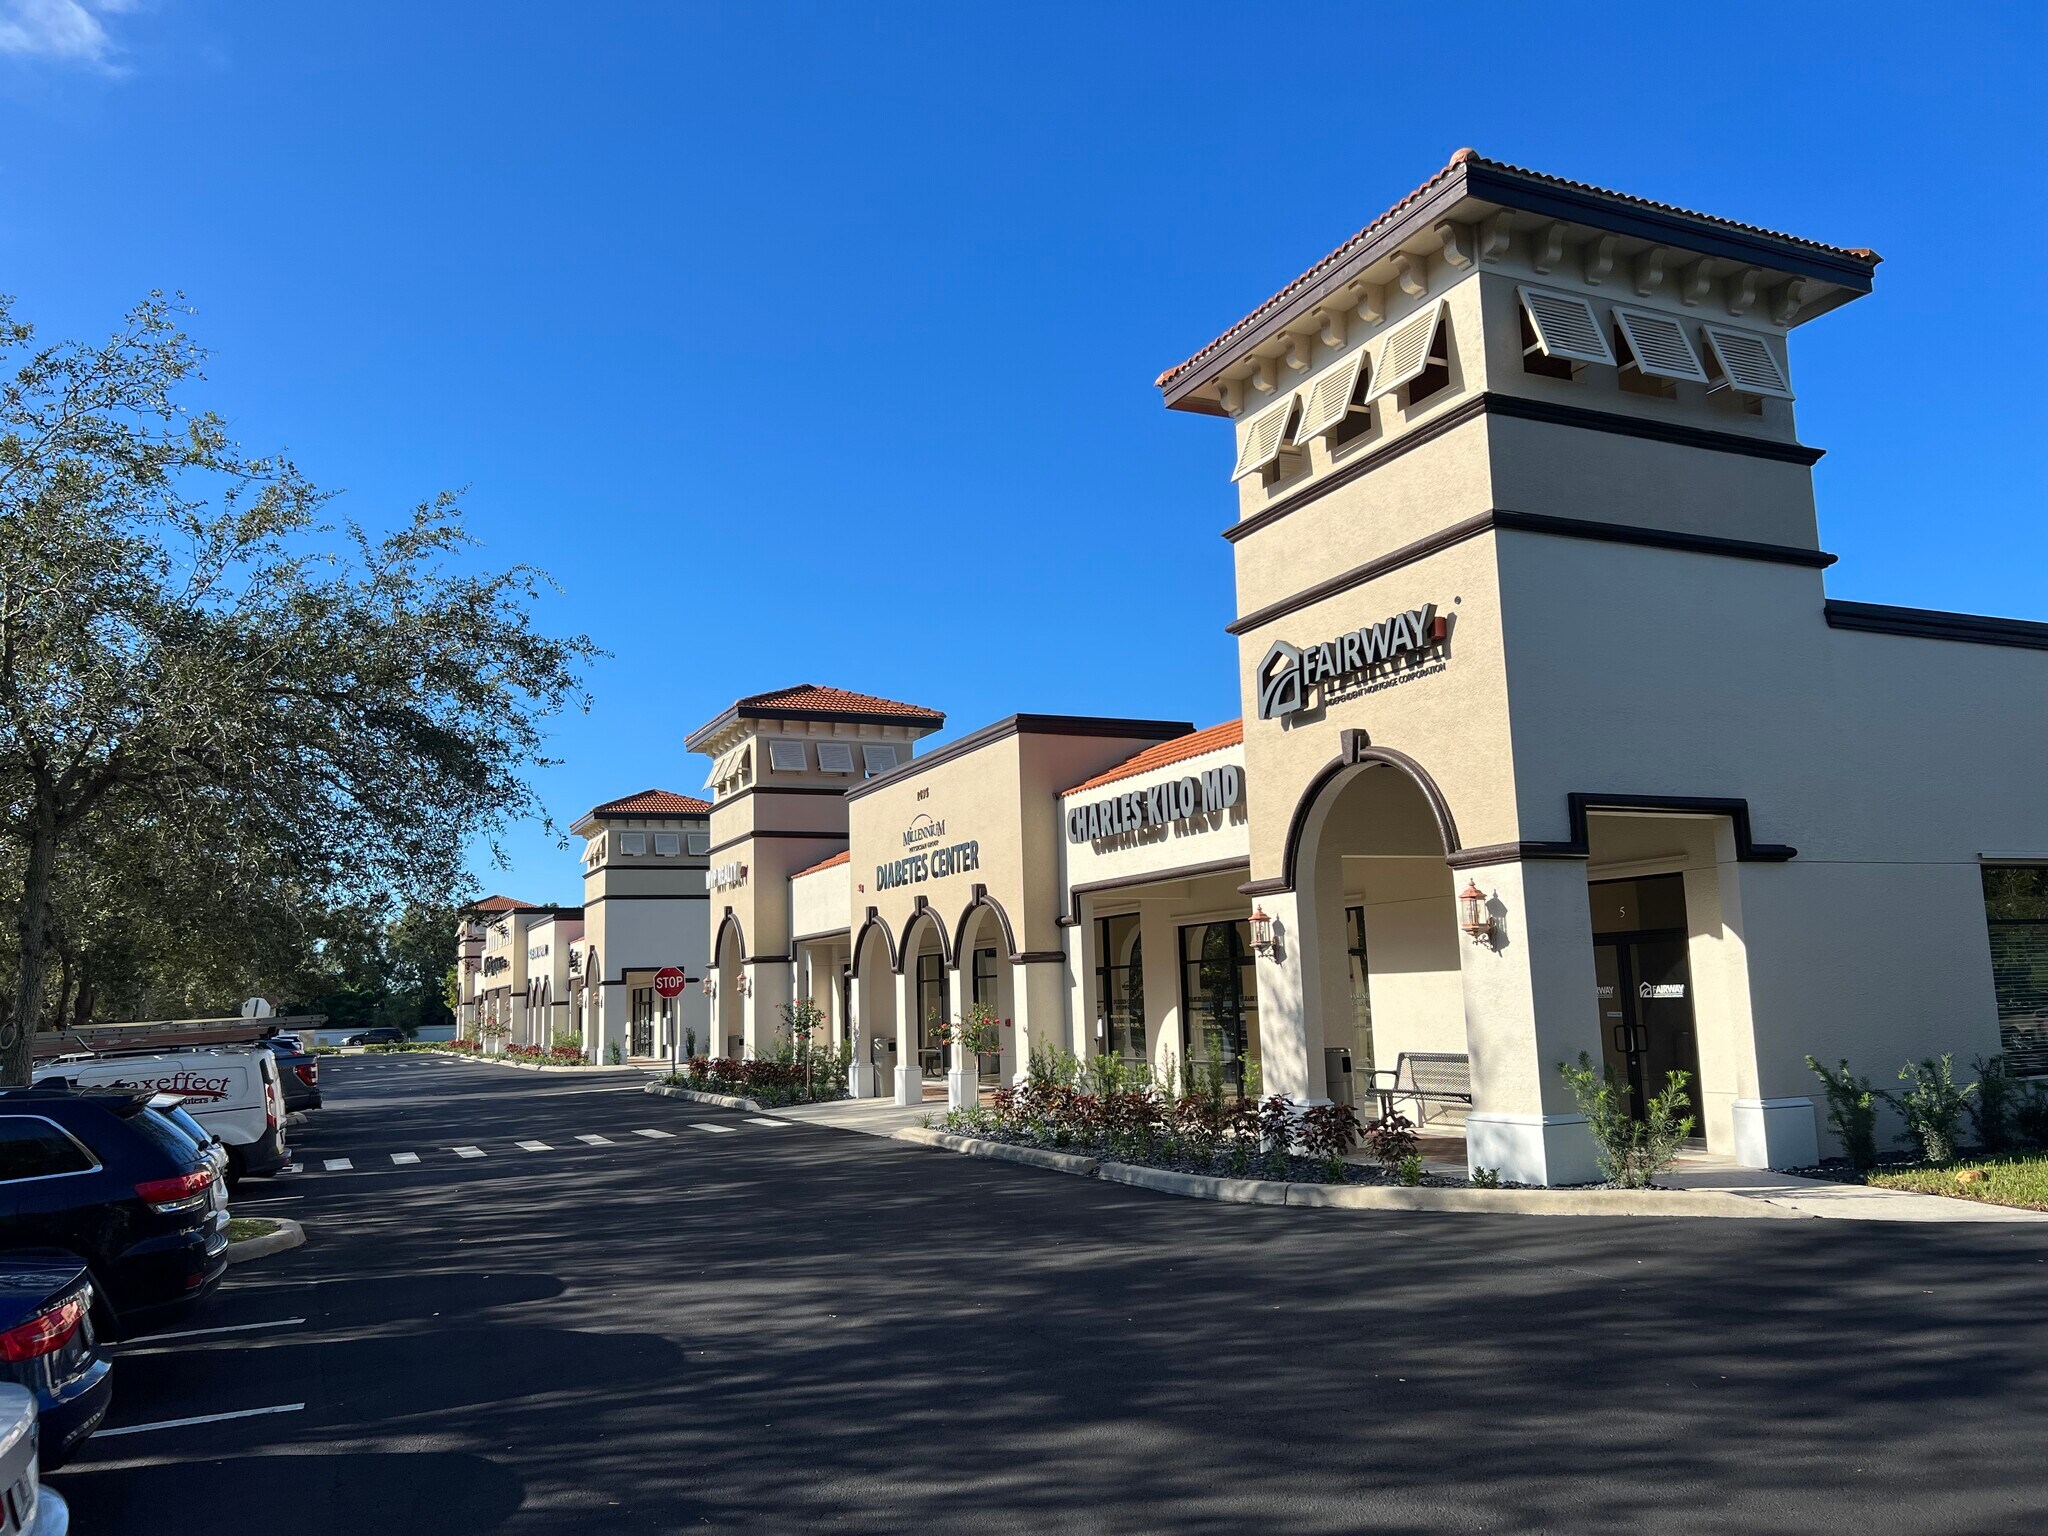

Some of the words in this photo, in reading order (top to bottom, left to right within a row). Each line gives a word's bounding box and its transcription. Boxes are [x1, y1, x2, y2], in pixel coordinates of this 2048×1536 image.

[1303, 603, 1437, 685] FAIRWAY
[1398, 662, 1446, 684] CORPORATION
[1067, 790, 1142, 844] CHARLES
[1146, 776, 1196, 826] KILO
[1201, 764, 1240, 813] MD
[903, 819, 945, 846] MILLENNIUM
[876, 853, 928, 891] DIABETES
[931, 840, 979, 878] CENTER
[1619, 906, 1626, 918] 5
[656, 976, 684, 989] STOP
[1652, 984, 1684, 994] FAIRWAY
